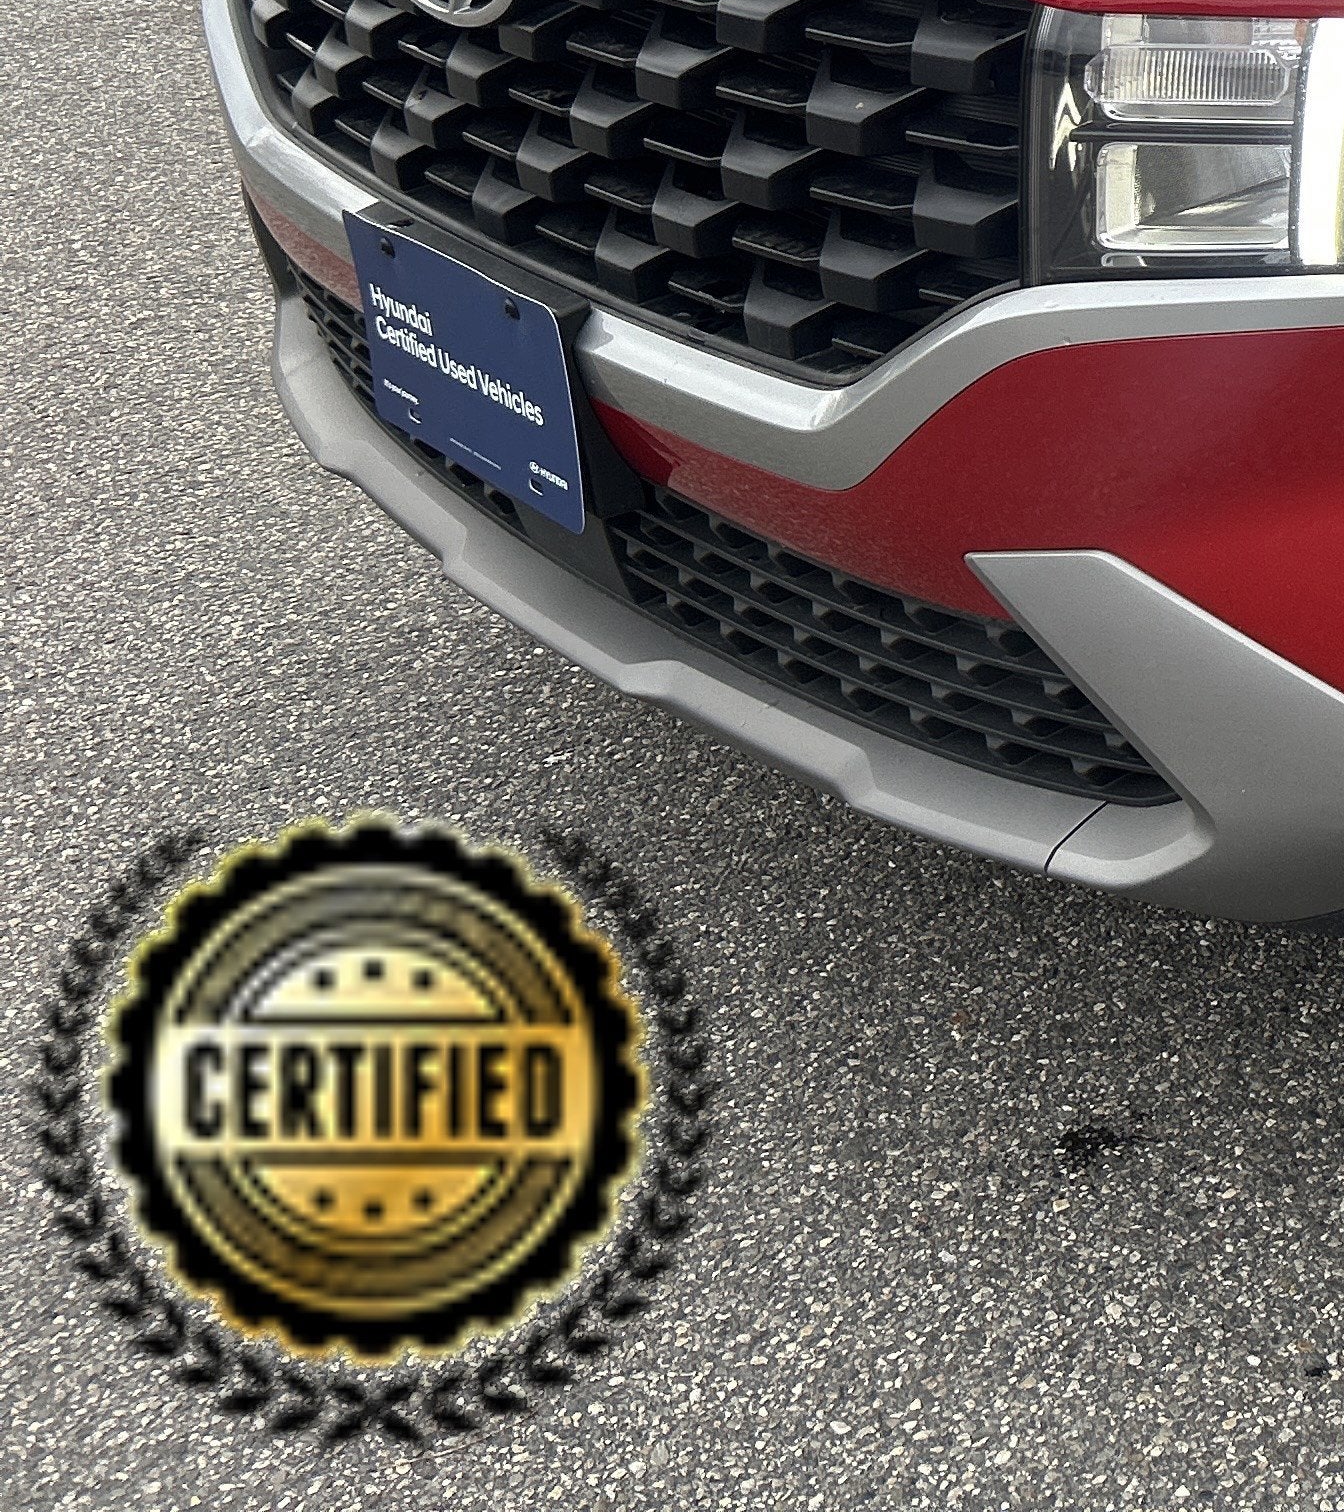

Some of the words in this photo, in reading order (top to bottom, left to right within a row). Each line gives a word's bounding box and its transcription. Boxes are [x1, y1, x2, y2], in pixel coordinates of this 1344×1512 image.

[369, 283, 434, 337] Hyundai
[375, 315, 438, 369] Certified
[437, 347, 479, 390] Used
[476, 369, 546, 427] Vehicles
